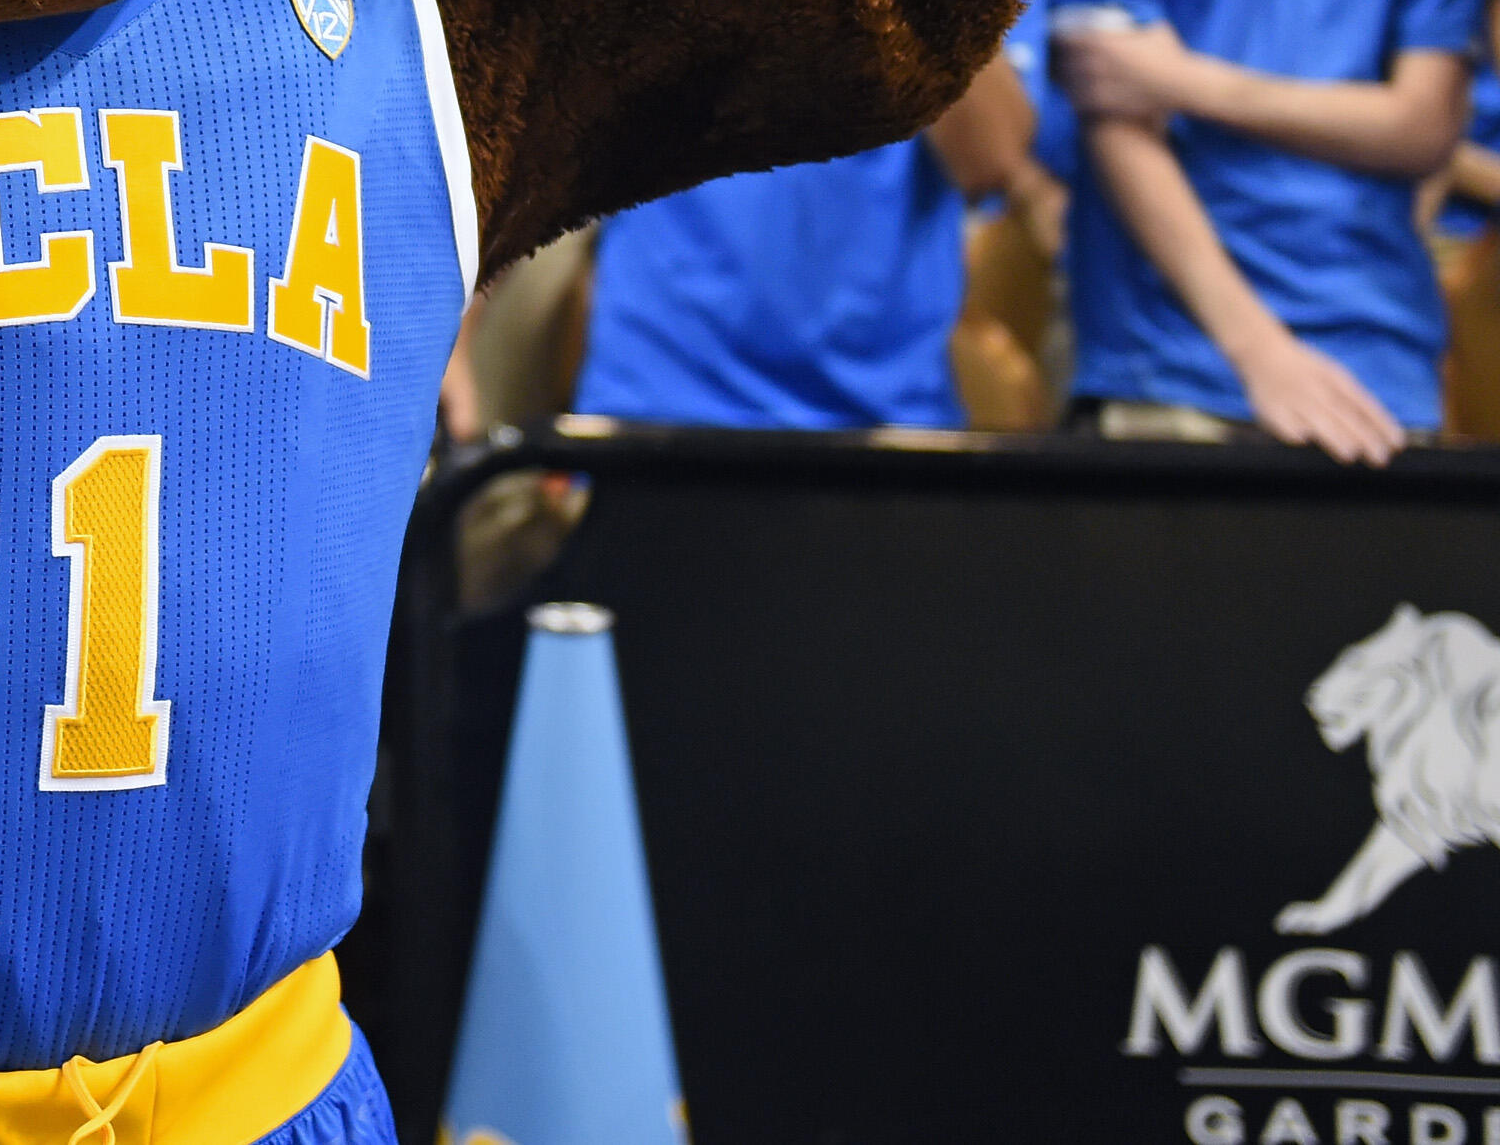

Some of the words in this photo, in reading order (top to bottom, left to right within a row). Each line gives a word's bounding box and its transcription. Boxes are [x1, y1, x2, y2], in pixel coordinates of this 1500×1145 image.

[311, 11, 343, 42] 12
[39, 434, 171, 791] 1
[1120, 944, 1500, 1064] MGM
